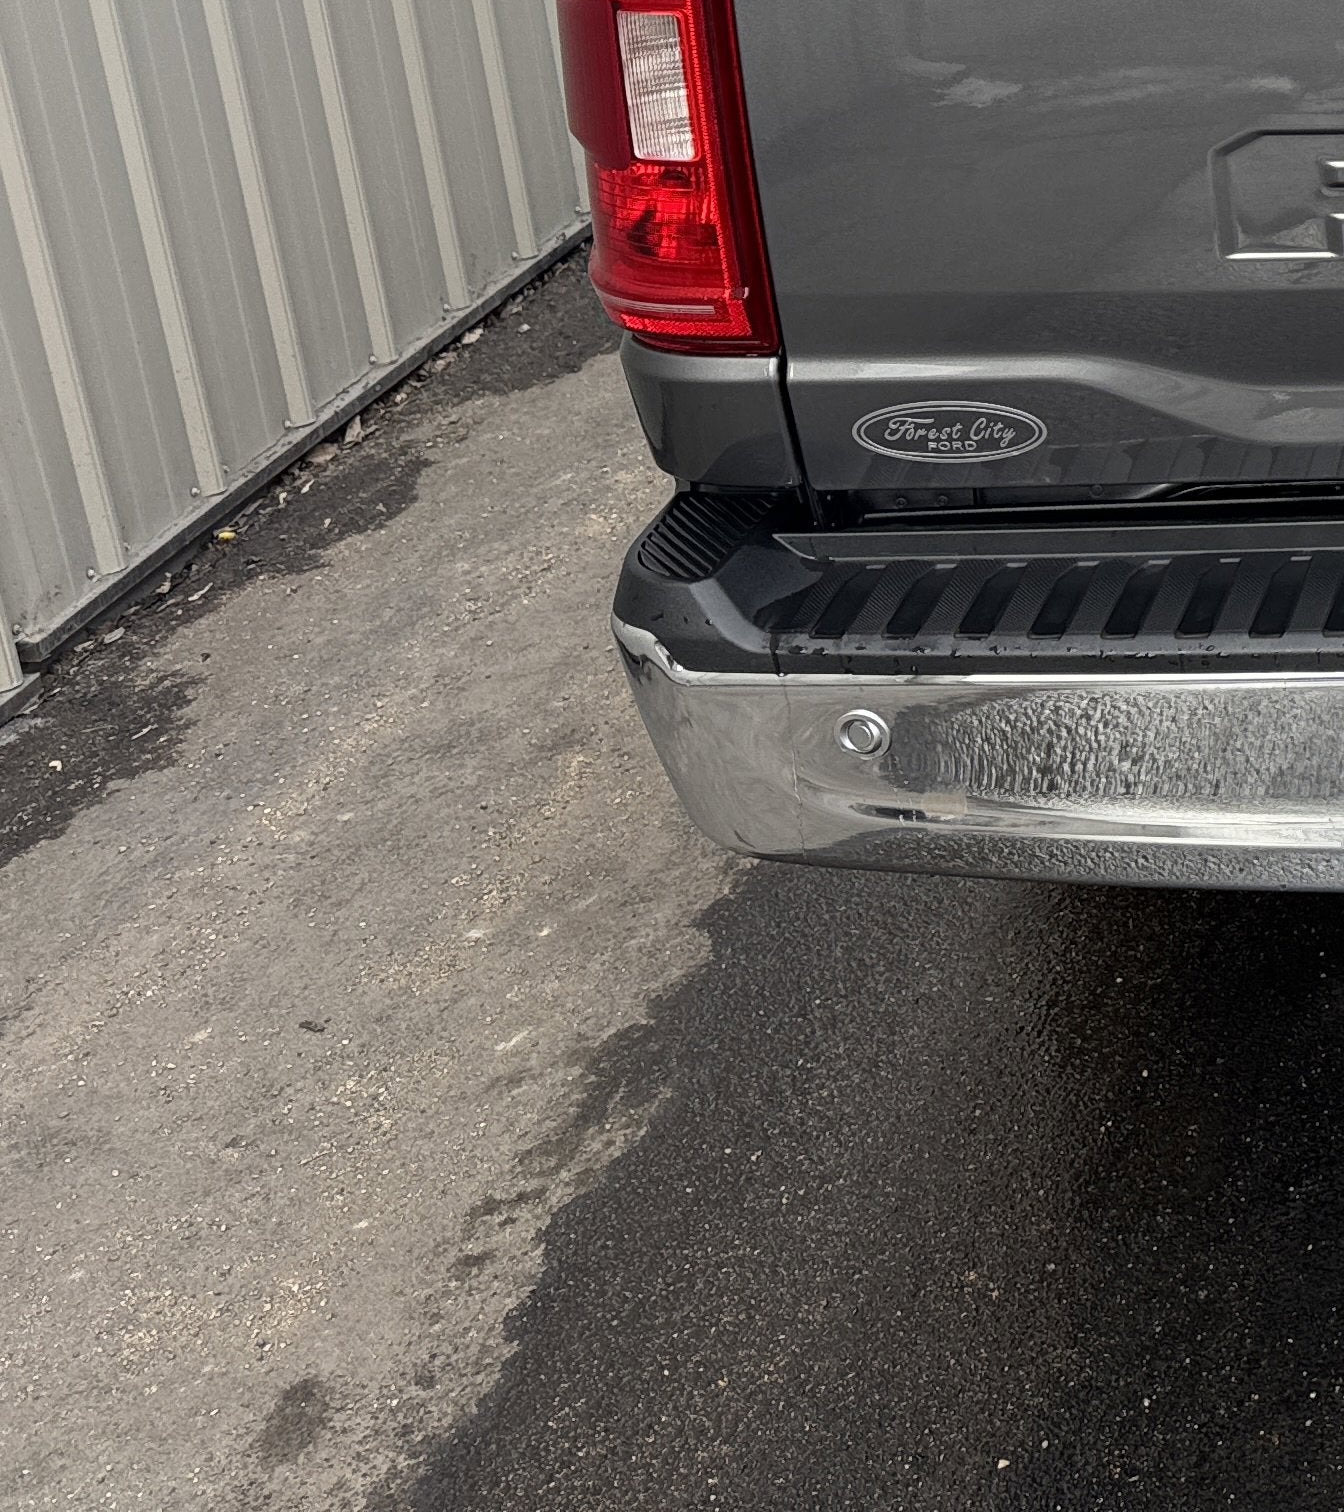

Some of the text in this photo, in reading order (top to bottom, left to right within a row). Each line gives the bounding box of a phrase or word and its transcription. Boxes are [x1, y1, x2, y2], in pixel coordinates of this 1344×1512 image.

[884, 417, 1016, 448] Forest City
[927, 441, 978, 451] FORD
